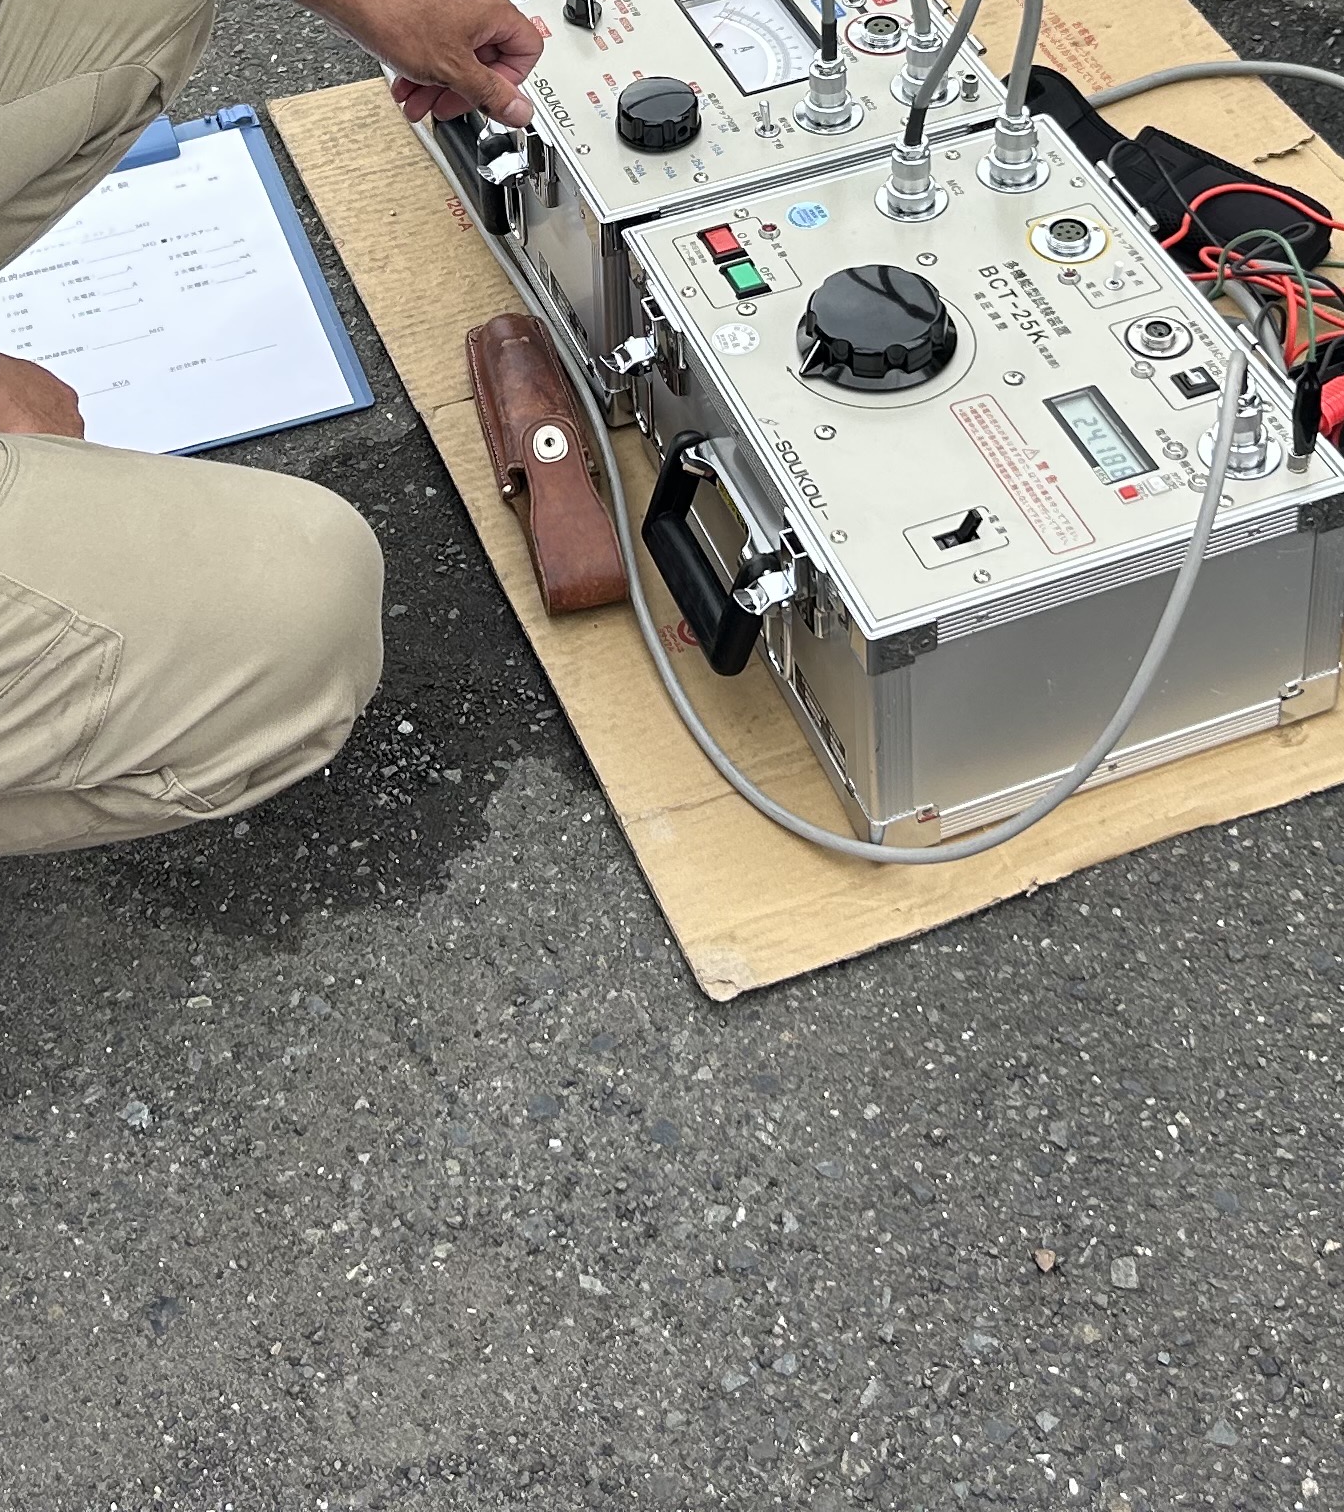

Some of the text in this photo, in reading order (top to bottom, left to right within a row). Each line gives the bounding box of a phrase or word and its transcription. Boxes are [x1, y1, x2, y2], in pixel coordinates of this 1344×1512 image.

[445, 195, 474, 232] 120-A
[737, 232, 752, 247] ON
[759, 267, 777, 282] OFF
[978, 265, 1050, 345] BCT-25K
[1002, 260, 1072, 337] 多機能型試験装置
